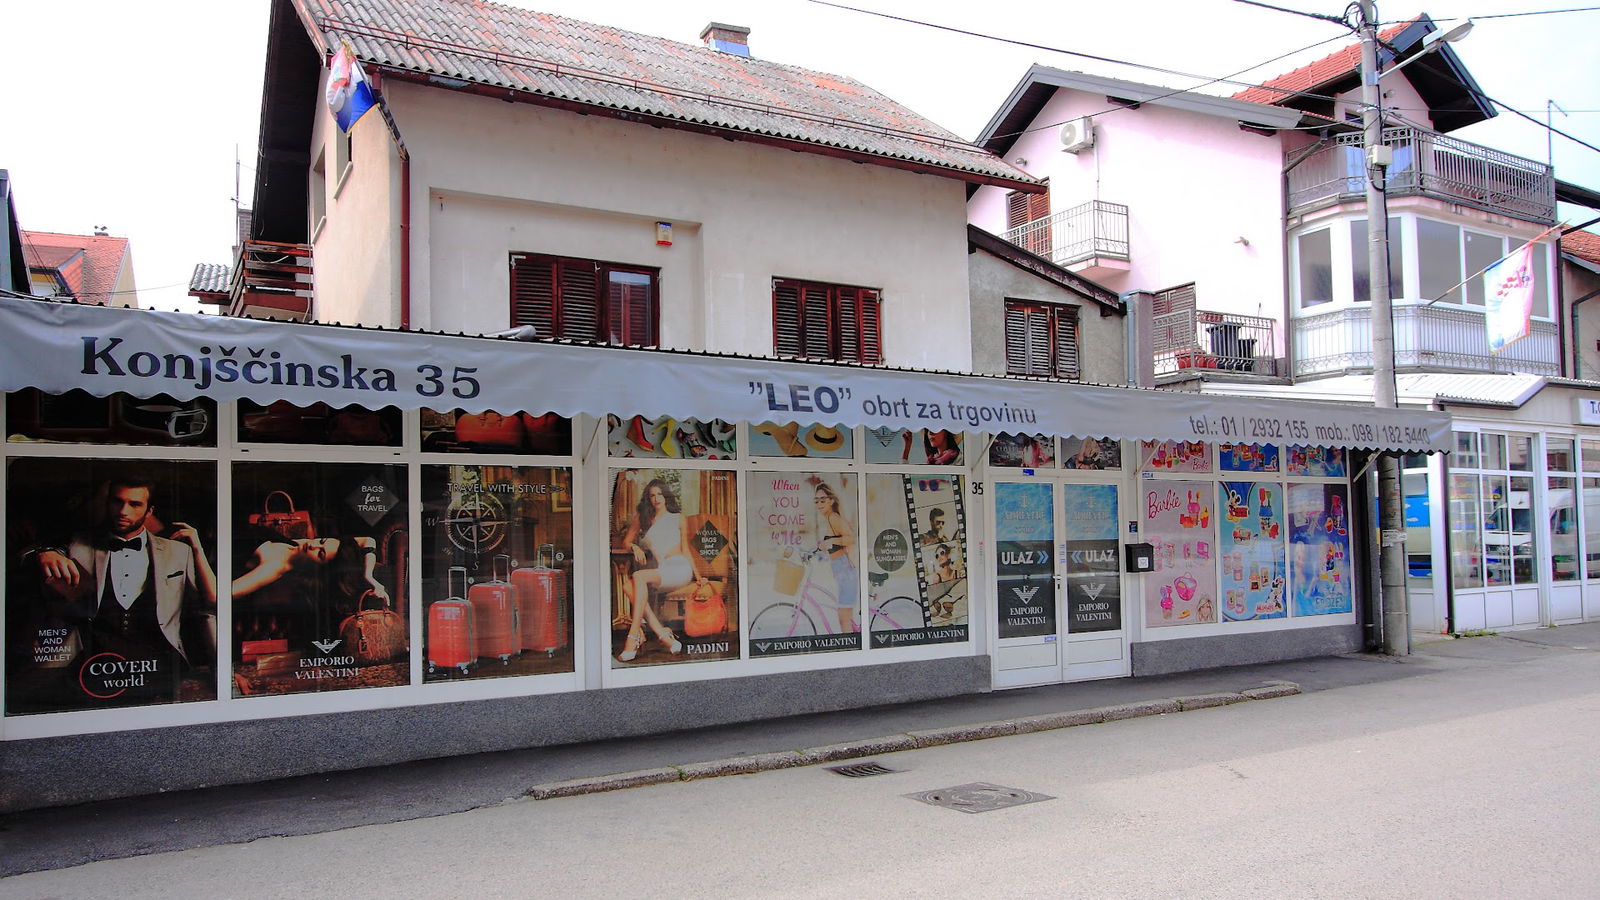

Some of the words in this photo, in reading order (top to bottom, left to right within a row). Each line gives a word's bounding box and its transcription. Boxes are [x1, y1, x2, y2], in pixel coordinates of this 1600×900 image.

[81, 336, 397, 391] Konjščinska
[416, 364, 480, 399] 35
[863, 395, 911, 418] obrt
[916, 402, 942, 419] za
[948, 401, 1037, 427] trgovinu
[1190, 416, 1219, 436] tel.:
[1221, 416, 1236, 436] 01
[1252, 418, 1283, 438] 2932
[1285, 419, 1309, 440] 155
[1315, 421, 1349, 442] mob.:
[1352, 423, 1374, 442] 098
[1382, 425, 1402, 443] 182
[1405, 426, 1431, 445] 5440
[361, 485, 384, 493] BAGS
[447, 483, 485, 493] TRAVEL
[488, 484, 515, 493] WITH
[518, 484, 546, 494] STYLE
[771, 479, 800, 490] When
[971, 482, 984, 495] 35
[365, 492, 381, 504] for
[773, 496, 799, 508] YOU
[1147, 489, 1180, 519] Barbie
[357, 504, 388, 512] TRAVEL
[768, 514, 805, 525] COME
[1002, 551, 1034, 565] ULAZ
[1085, 549, 1115, 563] ULAZ
[1010, 606, 1043, 616] EMPORIO
[1078, 602, 1109, 612] EMPORIO
[1007, 616, 1046, 626] VALENTINI
[1076, 612, 1112, 622] VALENTINI
[42, 637, 63, 645] AND
[891, 632, 925, 642] EMPORIO
[927, 629, 964, 639] VALENTINI
[687, 642, 729, 655] PADINI
[774, 640, 811, 651] EMPORIO
[815, 636, 857, 648] VALENTINI
[34, 646, 71, 654] WOMAN
[34, 653, 72, 663] WALLET
[300, 656, 355, 668] EMPORIO
[90, 659, 158, 676] COVERI
[294, 667, 359, 680] VALENTINI
[103, 674, 145, 688] world
